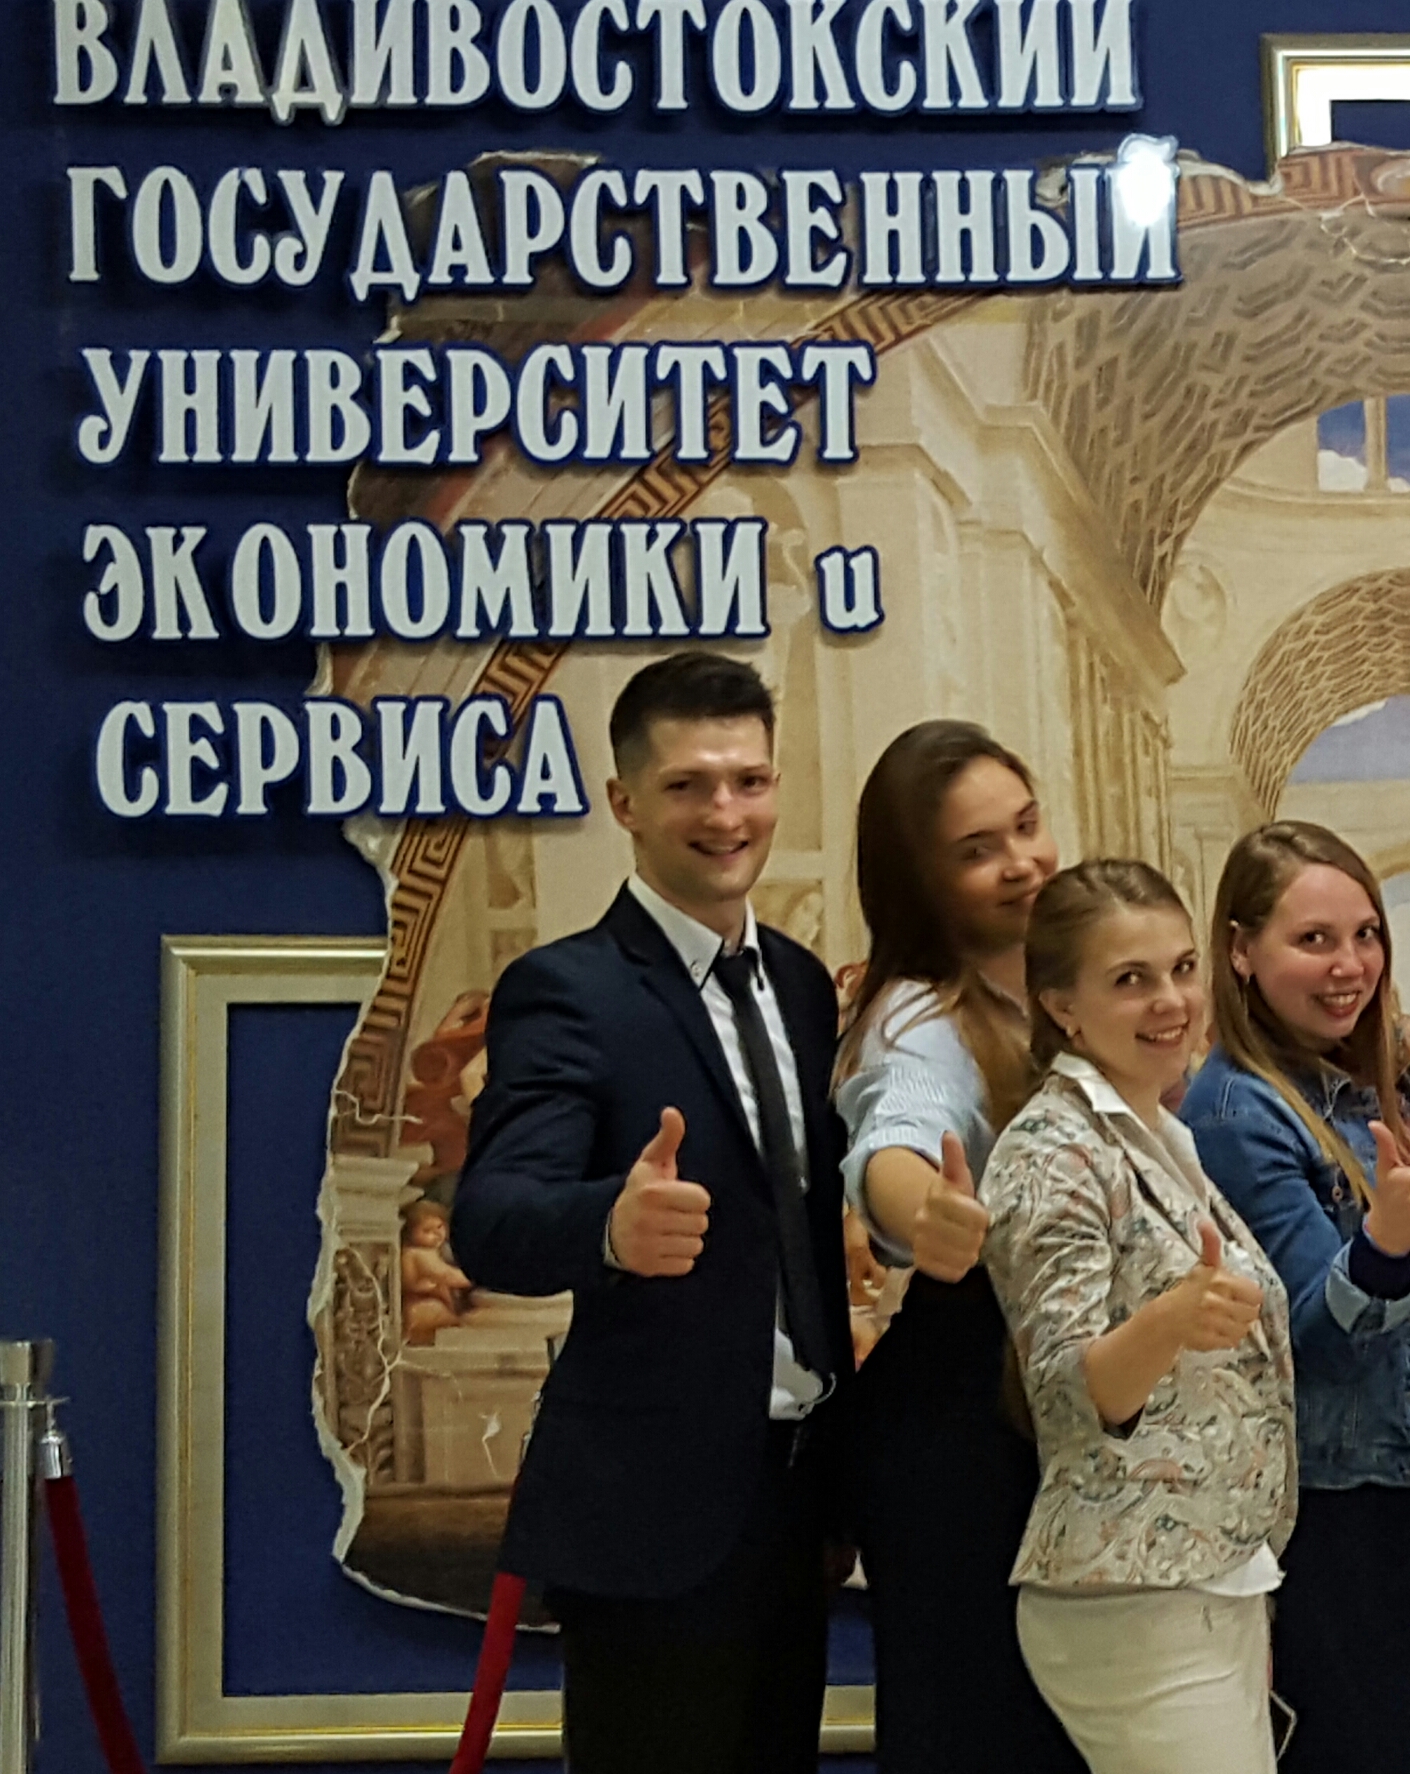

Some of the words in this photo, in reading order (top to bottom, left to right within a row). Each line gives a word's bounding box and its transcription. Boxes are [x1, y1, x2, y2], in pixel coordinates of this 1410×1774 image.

[66, 134, 1182, 301] ГОСУДАРСТВЕННЫЙ
[78, 343, 875, 463] УНИВЕРСИТЕТ
[82, 519, 768, 641] ЭКОНОМИКИ
[96, 700, 583, 816] СЕРВИСА
